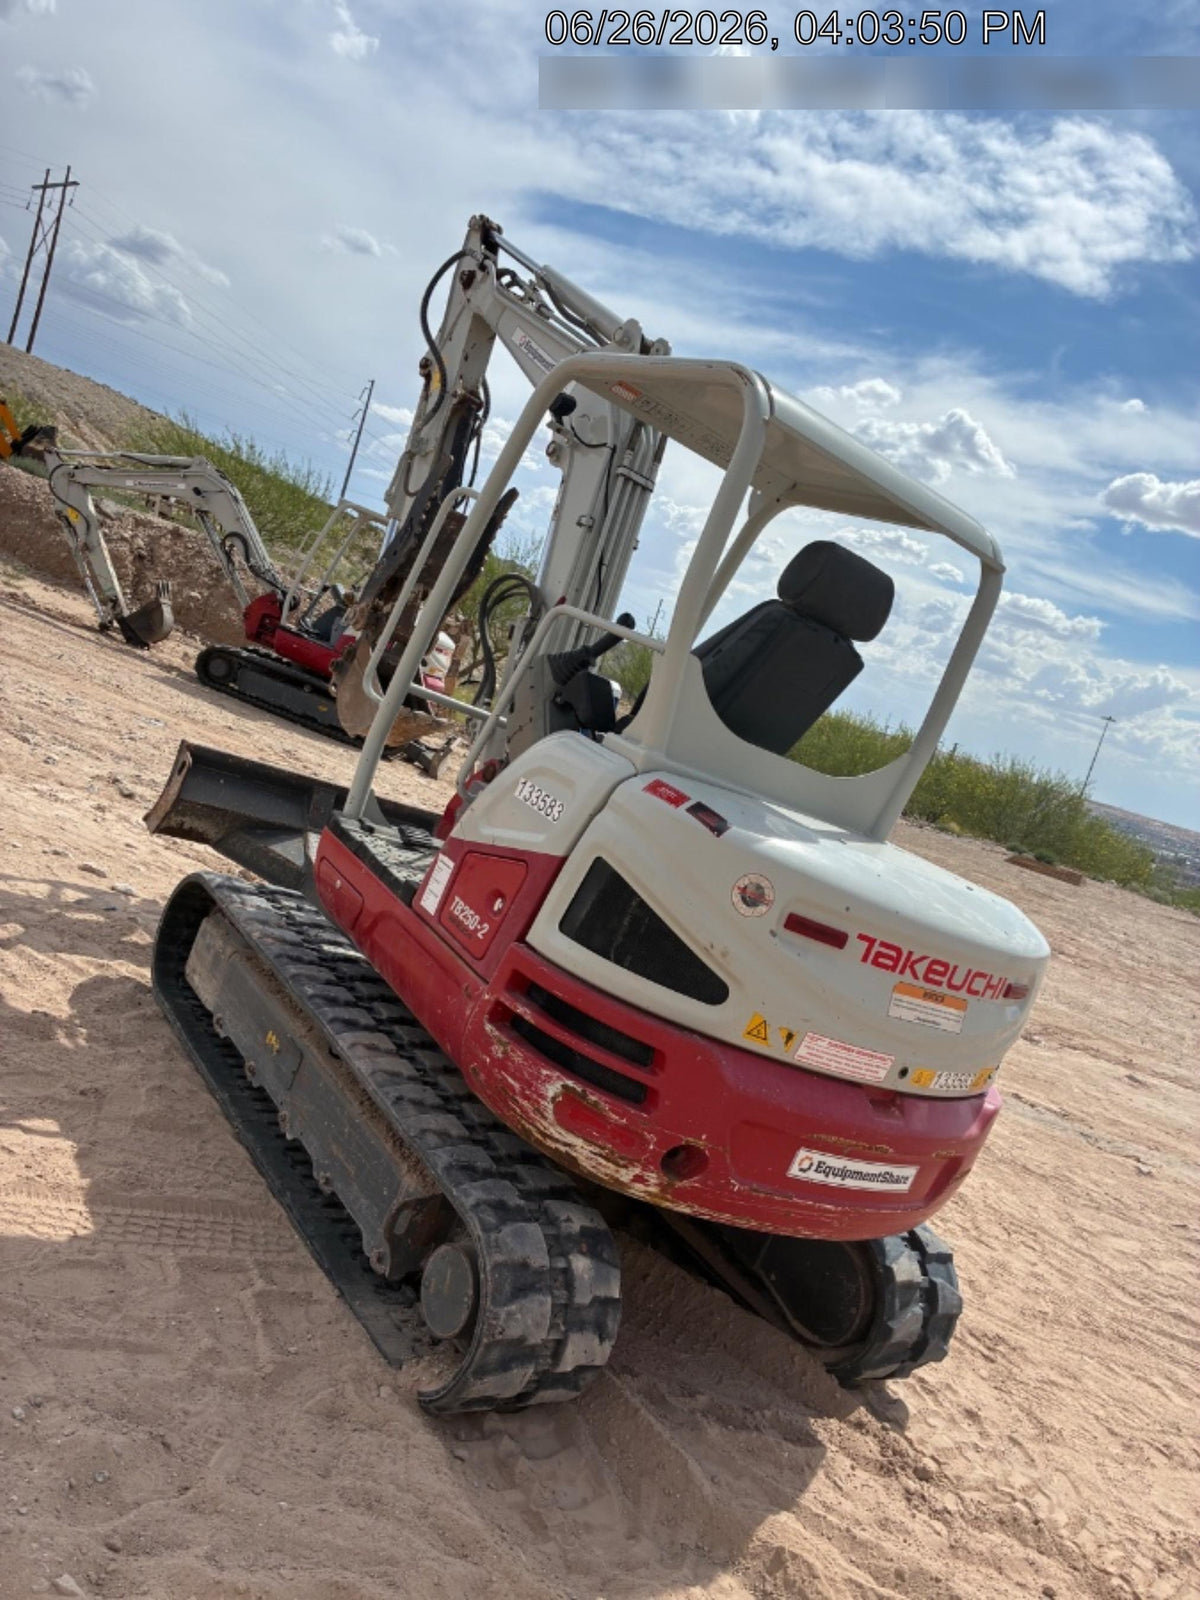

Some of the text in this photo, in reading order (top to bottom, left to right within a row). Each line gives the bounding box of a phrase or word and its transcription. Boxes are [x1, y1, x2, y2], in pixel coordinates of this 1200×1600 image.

[516, 779, 565, 822] 133583
[450, 896, 490, 939] TB250-2
[814, 1159, 913, 1185] EquipmentShare
